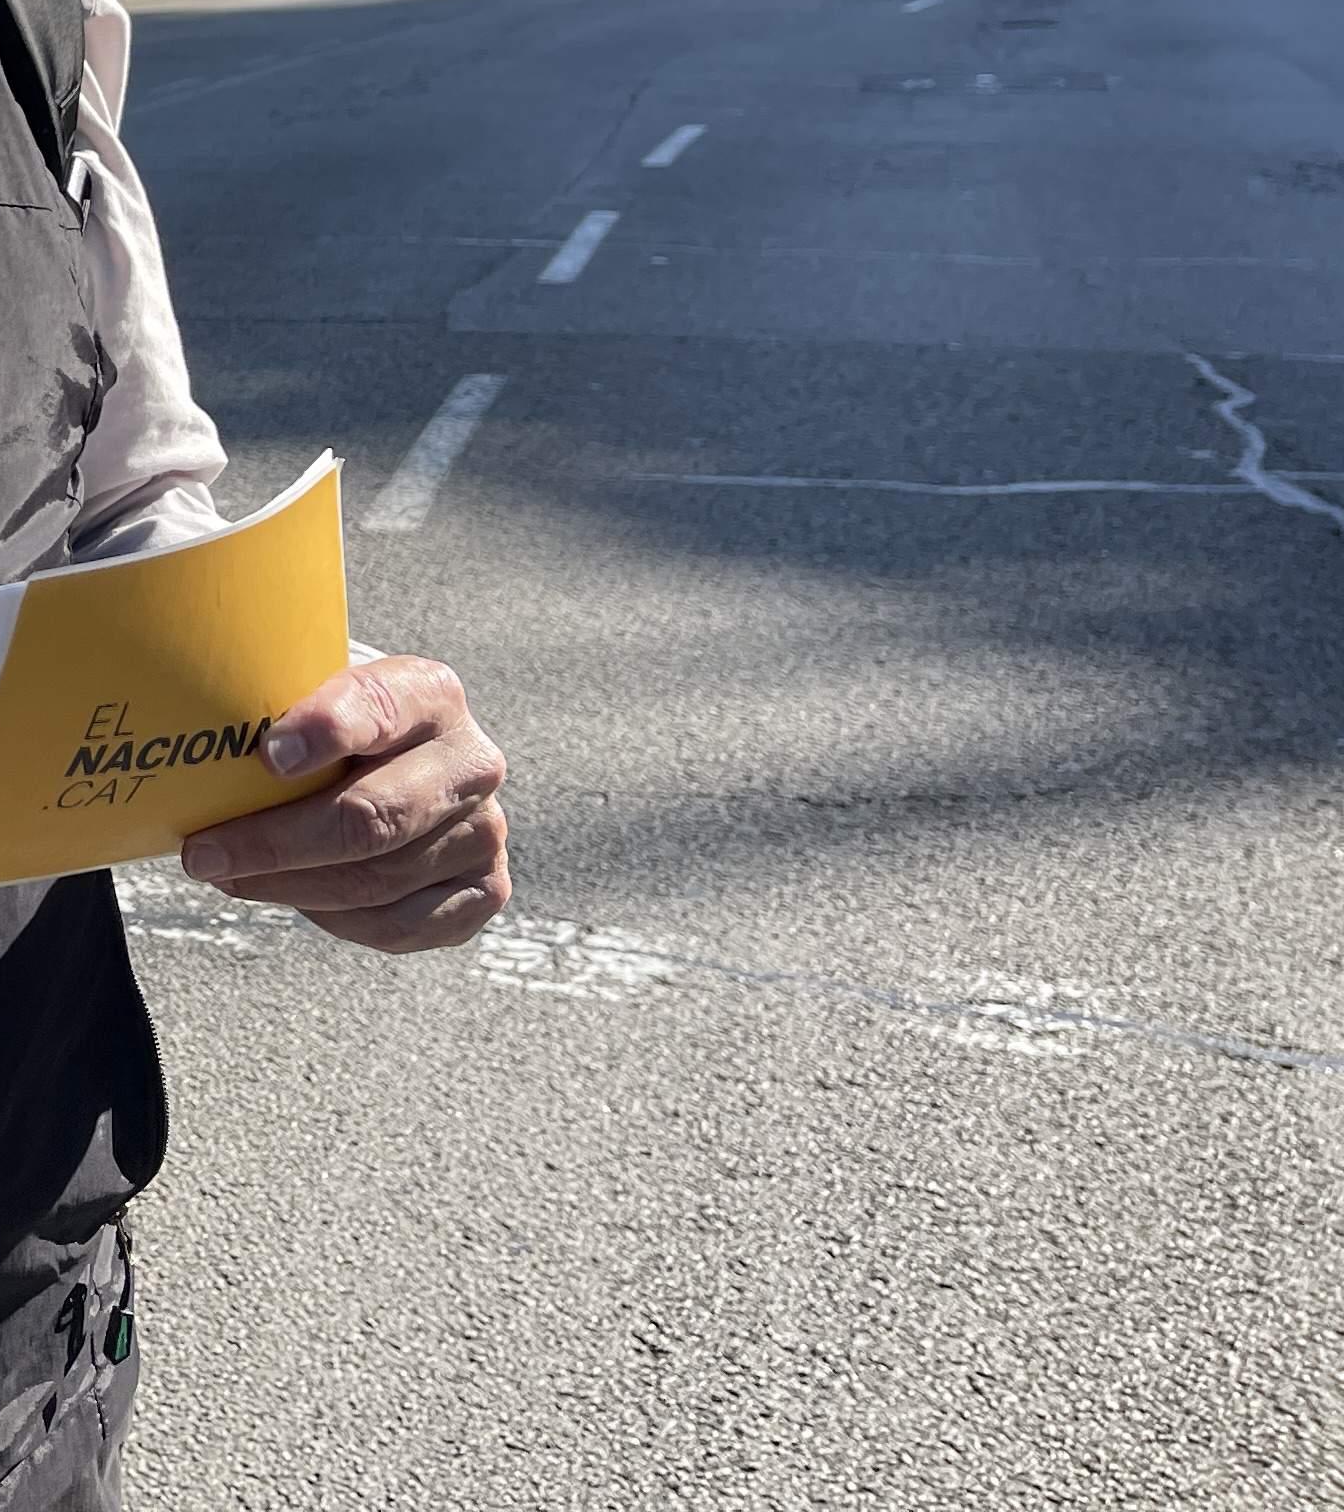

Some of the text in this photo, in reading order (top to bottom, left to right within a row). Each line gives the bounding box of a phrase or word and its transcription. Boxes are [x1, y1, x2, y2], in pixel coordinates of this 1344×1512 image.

[84, 701, 134, 741] EL
[64, 710, 288, 778] NACIONA
[41, 774, 157, 811] .CAT
